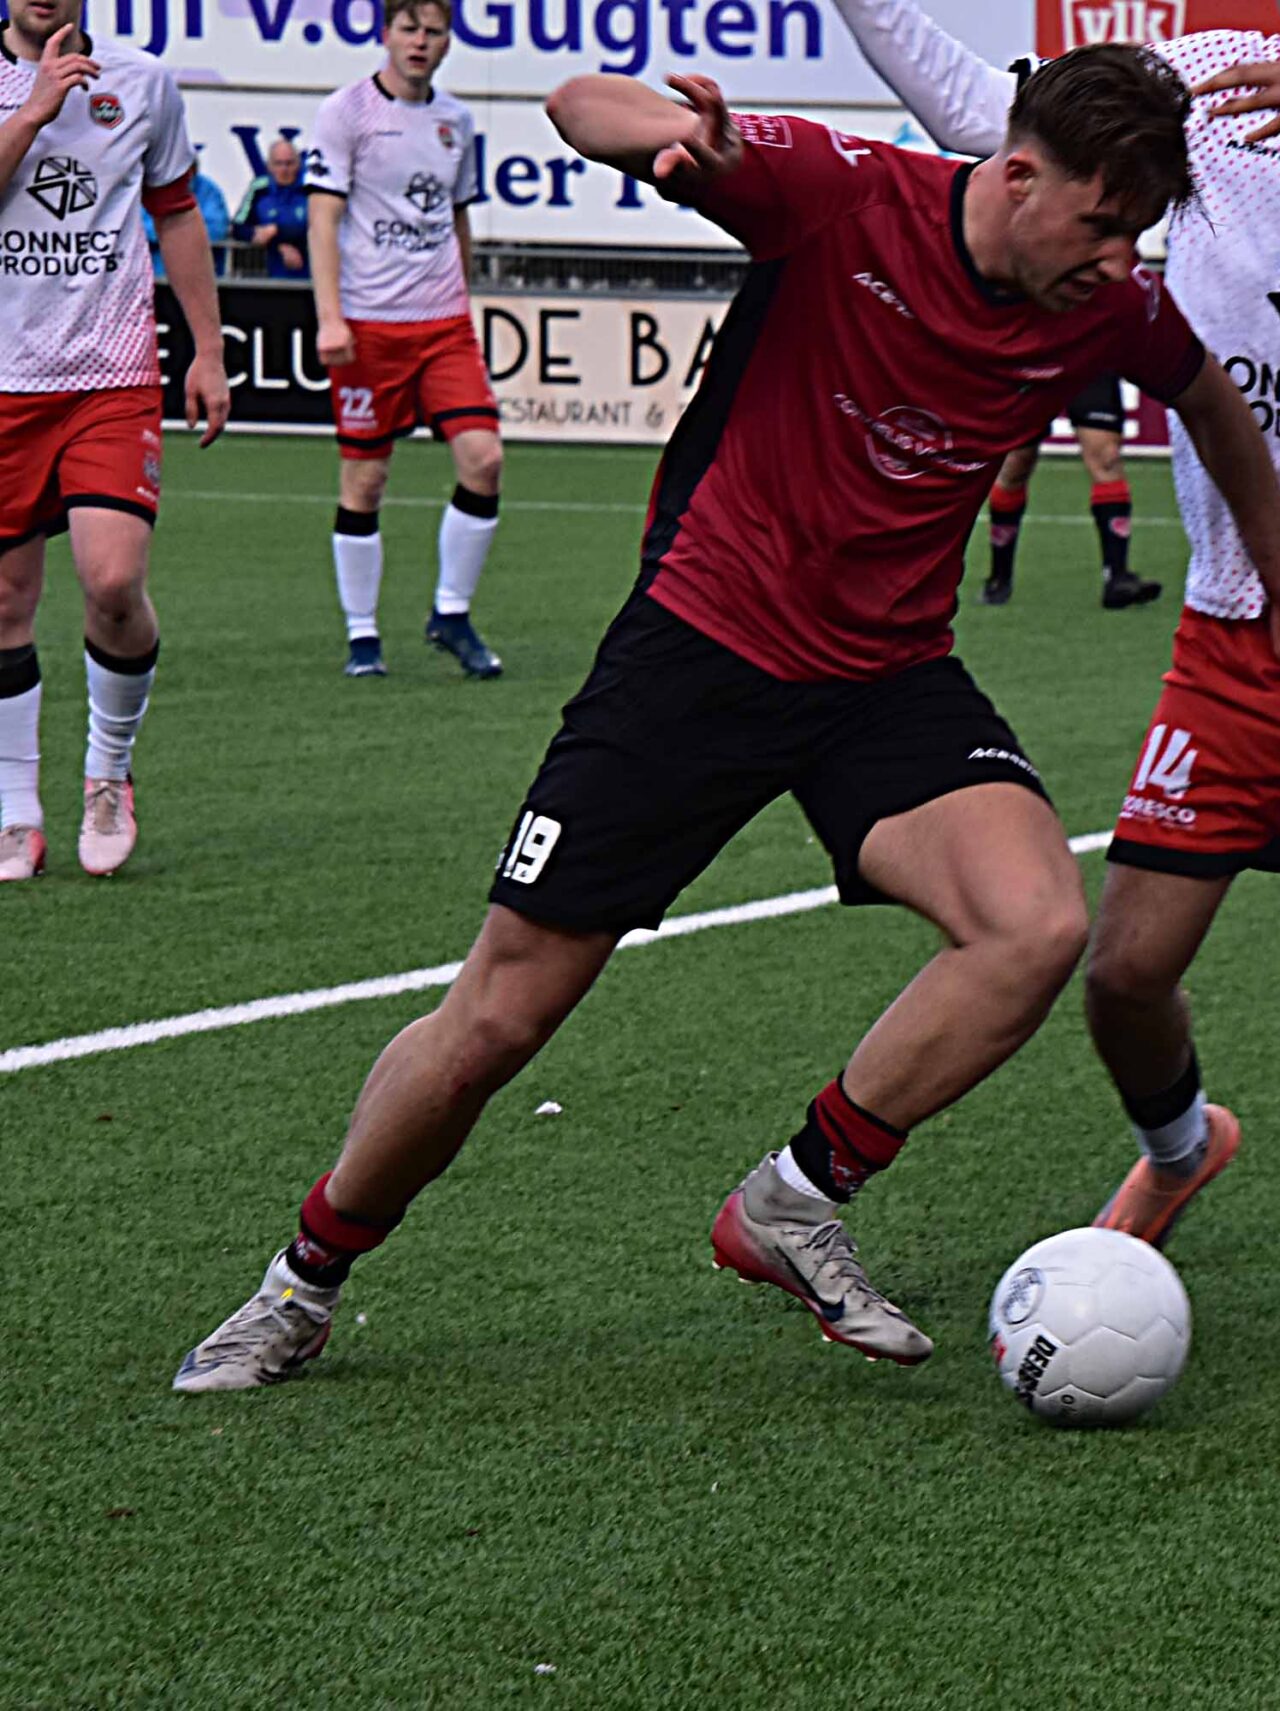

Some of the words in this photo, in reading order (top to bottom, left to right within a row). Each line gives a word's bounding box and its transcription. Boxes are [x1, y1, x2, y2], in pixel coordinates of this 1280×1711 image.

[450, 0, 823, 78] Gugten
[631, 311, 719, 389] BA
[339, 387, 374, 419] 22
[499, 398, 633, 427] ESTAURANT
[1132, 723, 1199, 800] 14
[502, 810, 563, 885] 19
